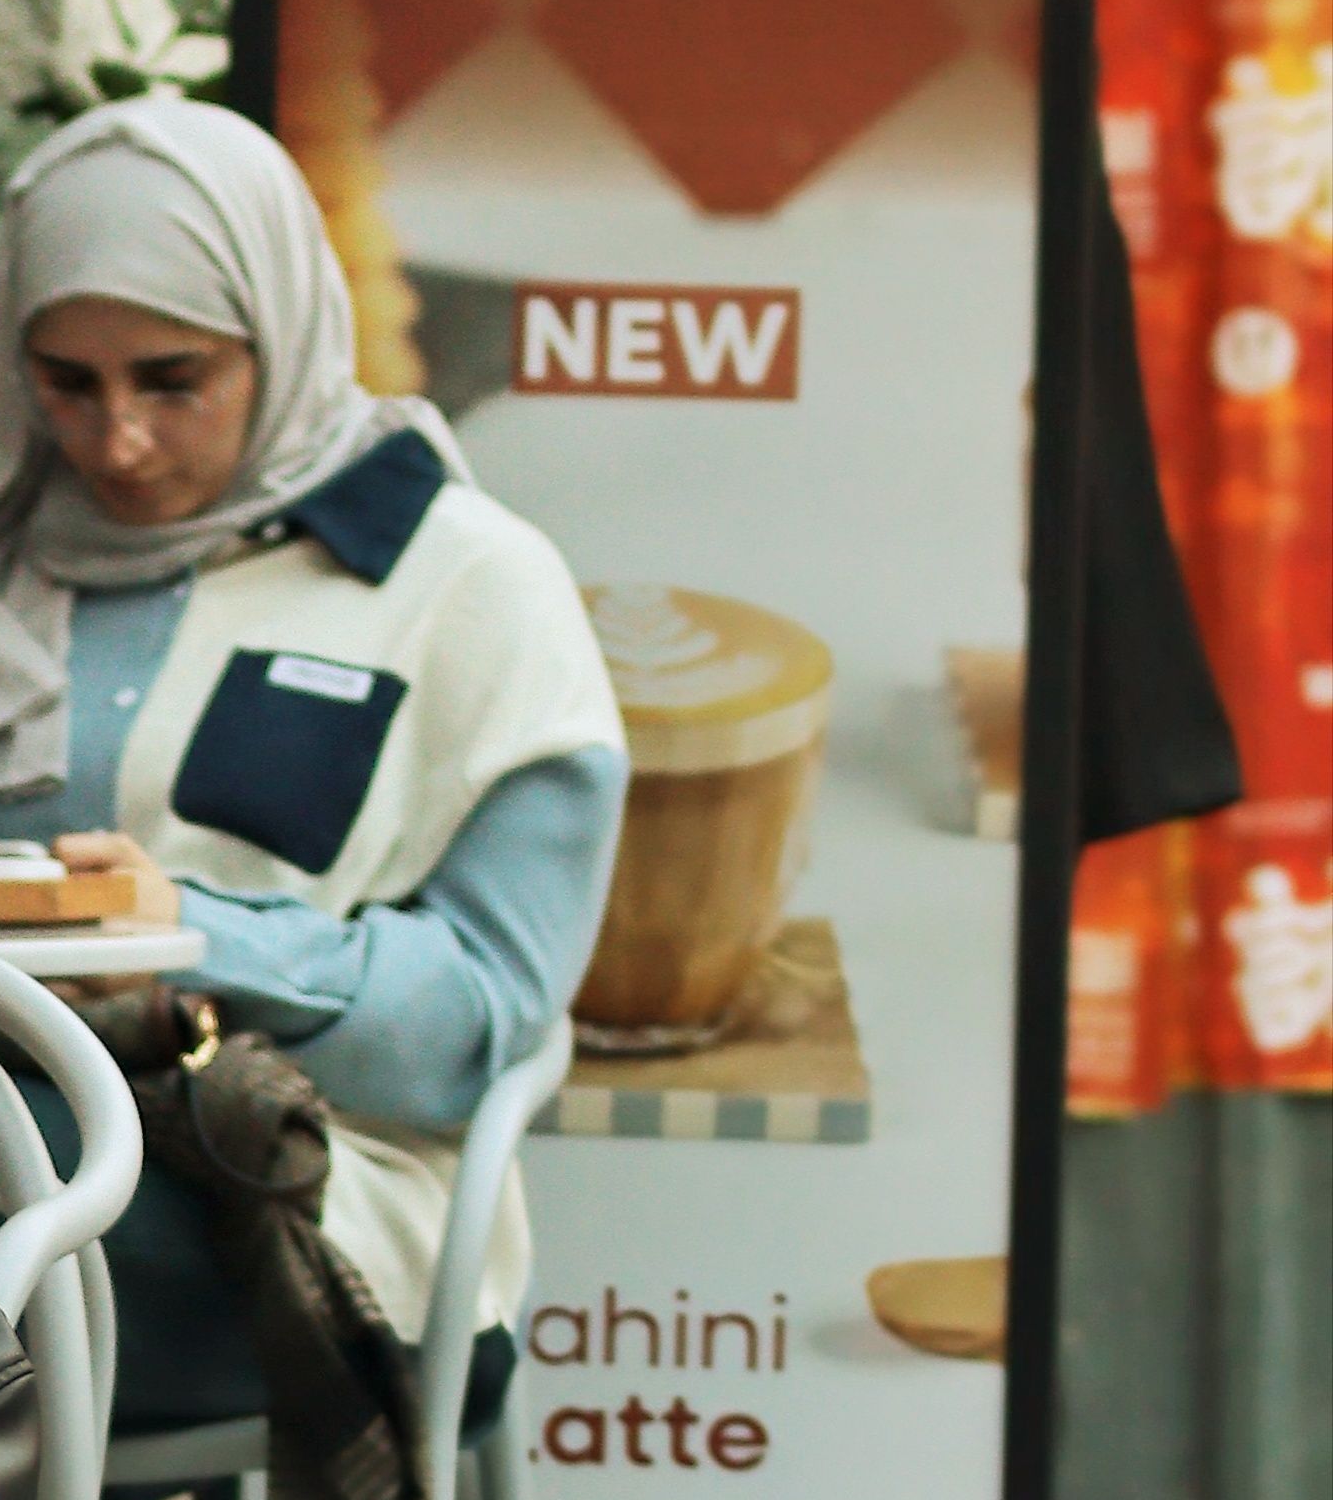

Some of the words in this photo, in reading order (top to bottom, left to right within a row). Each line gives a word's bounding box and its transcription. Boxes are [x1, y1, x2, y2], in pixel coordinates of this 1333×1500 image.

[523, 297, 789, 387] NEW
[528, 1286, 788, 1371] ahini
[529, 1396, 769, 1470] atte
